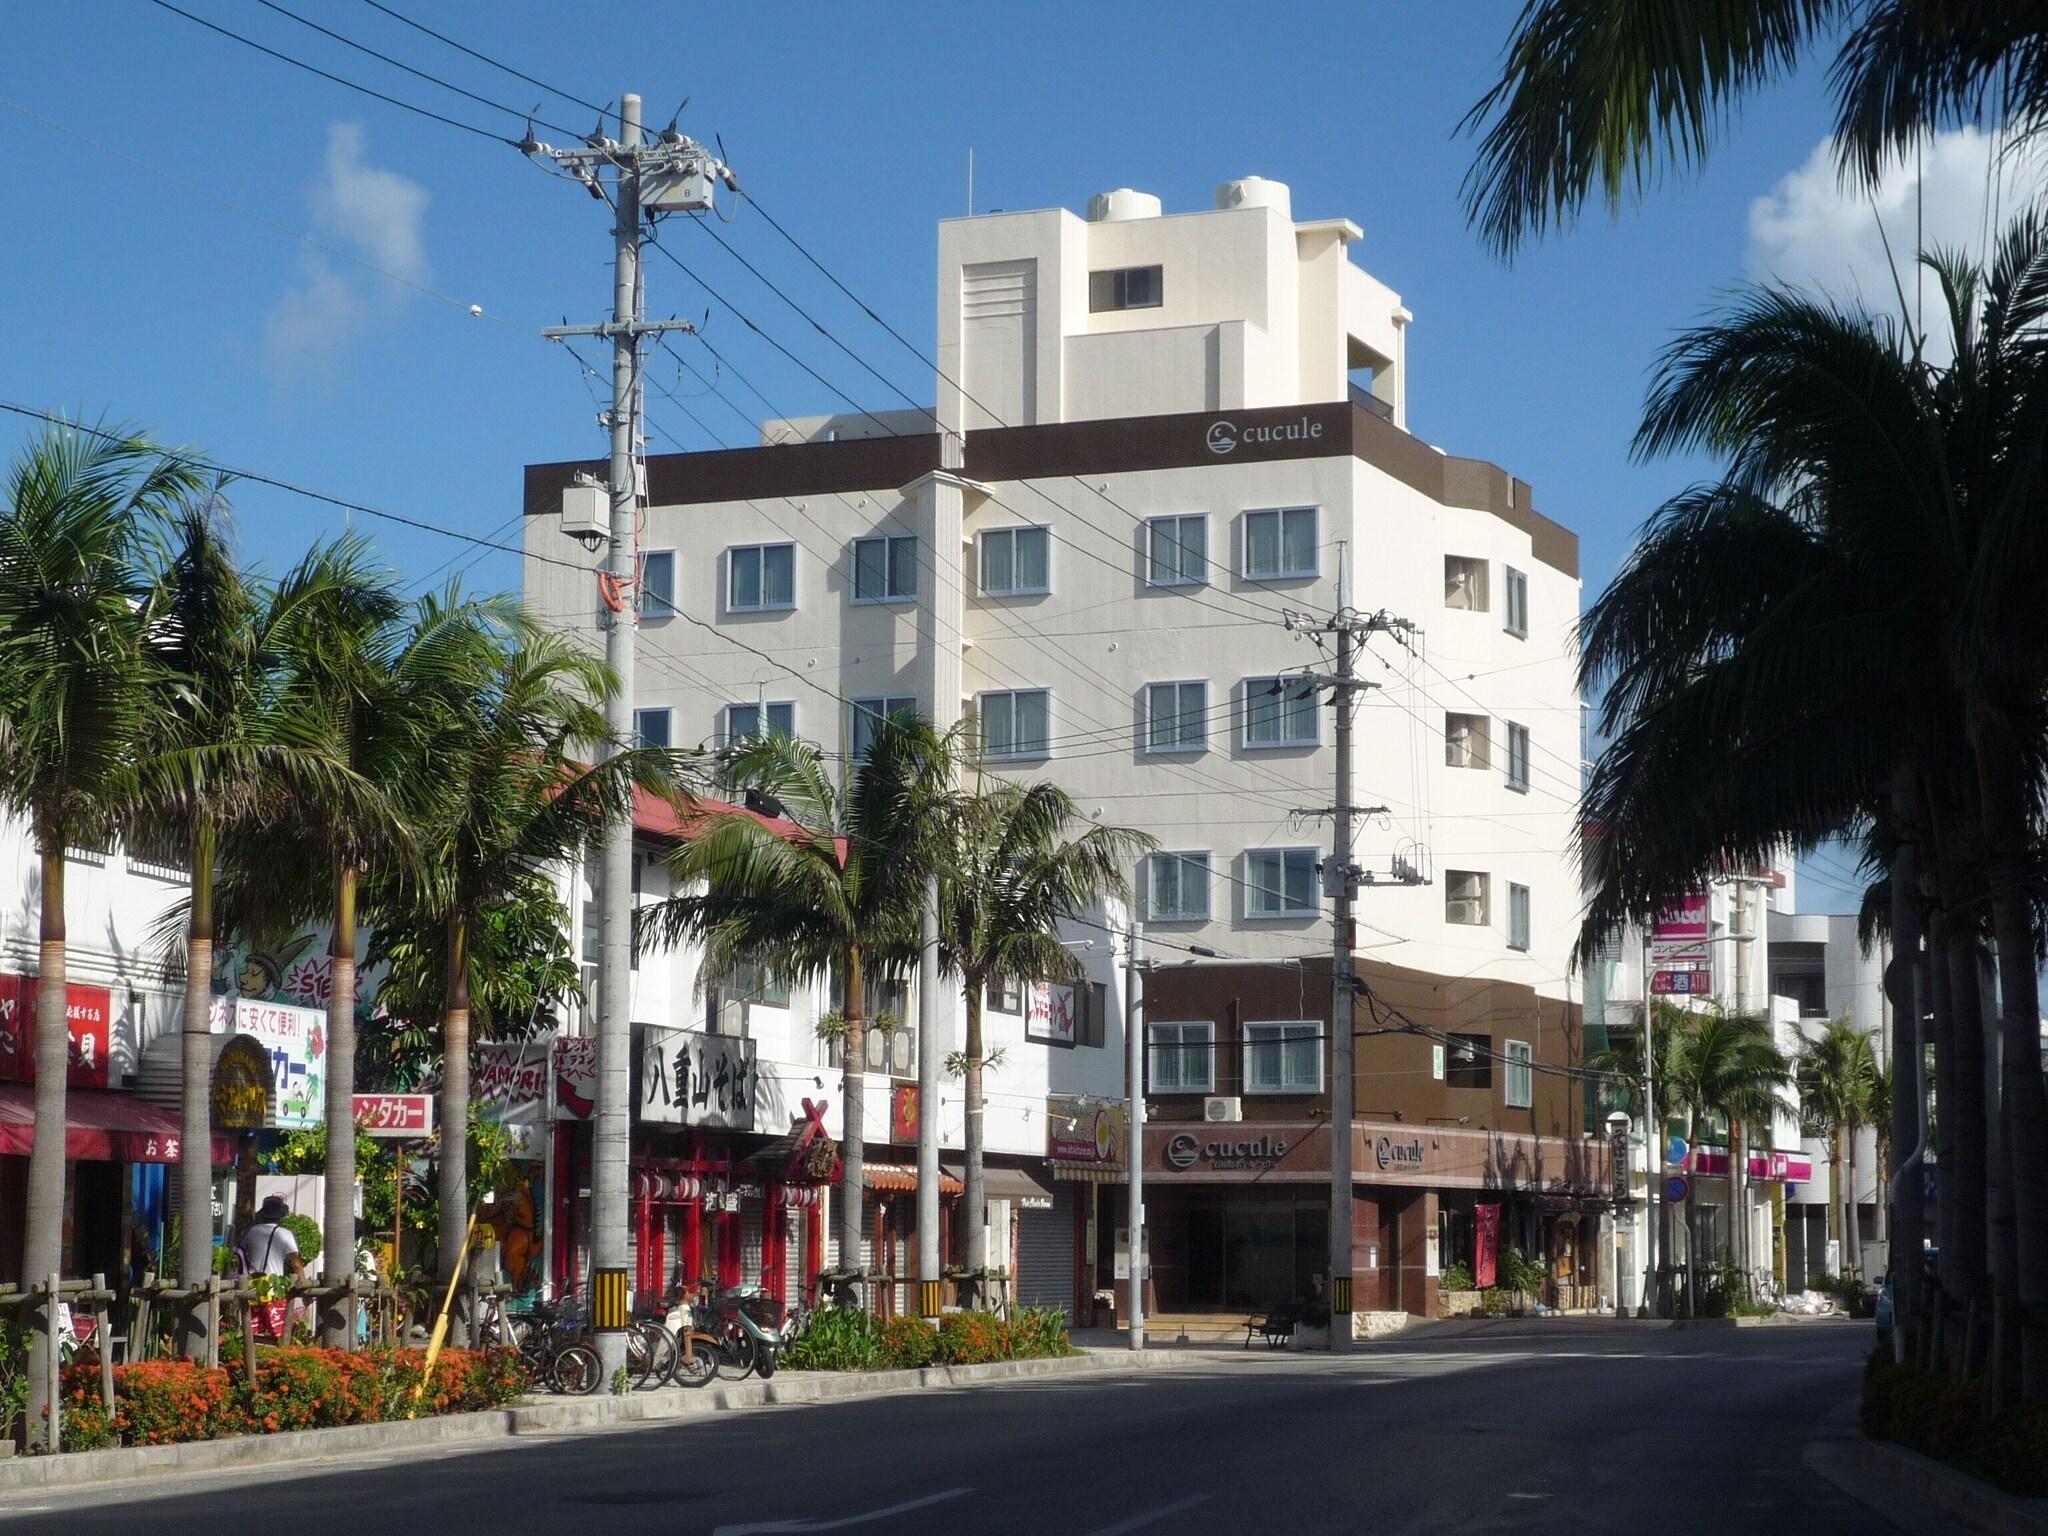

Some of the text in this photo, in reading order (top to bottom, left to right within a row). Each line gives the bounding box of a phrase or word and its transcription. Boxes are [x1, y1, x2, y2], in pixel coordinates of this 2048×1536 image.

[1243, 416, 1322, 442] cucule
[1673, 974, 1689, 991] 酒
[1690, 974, 1708, 991] ATM
[647, 1041, 750, 1112] 八重山そば
[145, 1139, 180, 1159] お茶
[1205, 1134, 1288, 1157] cucule
[1391, 1139, 1424, 1162] cucule
